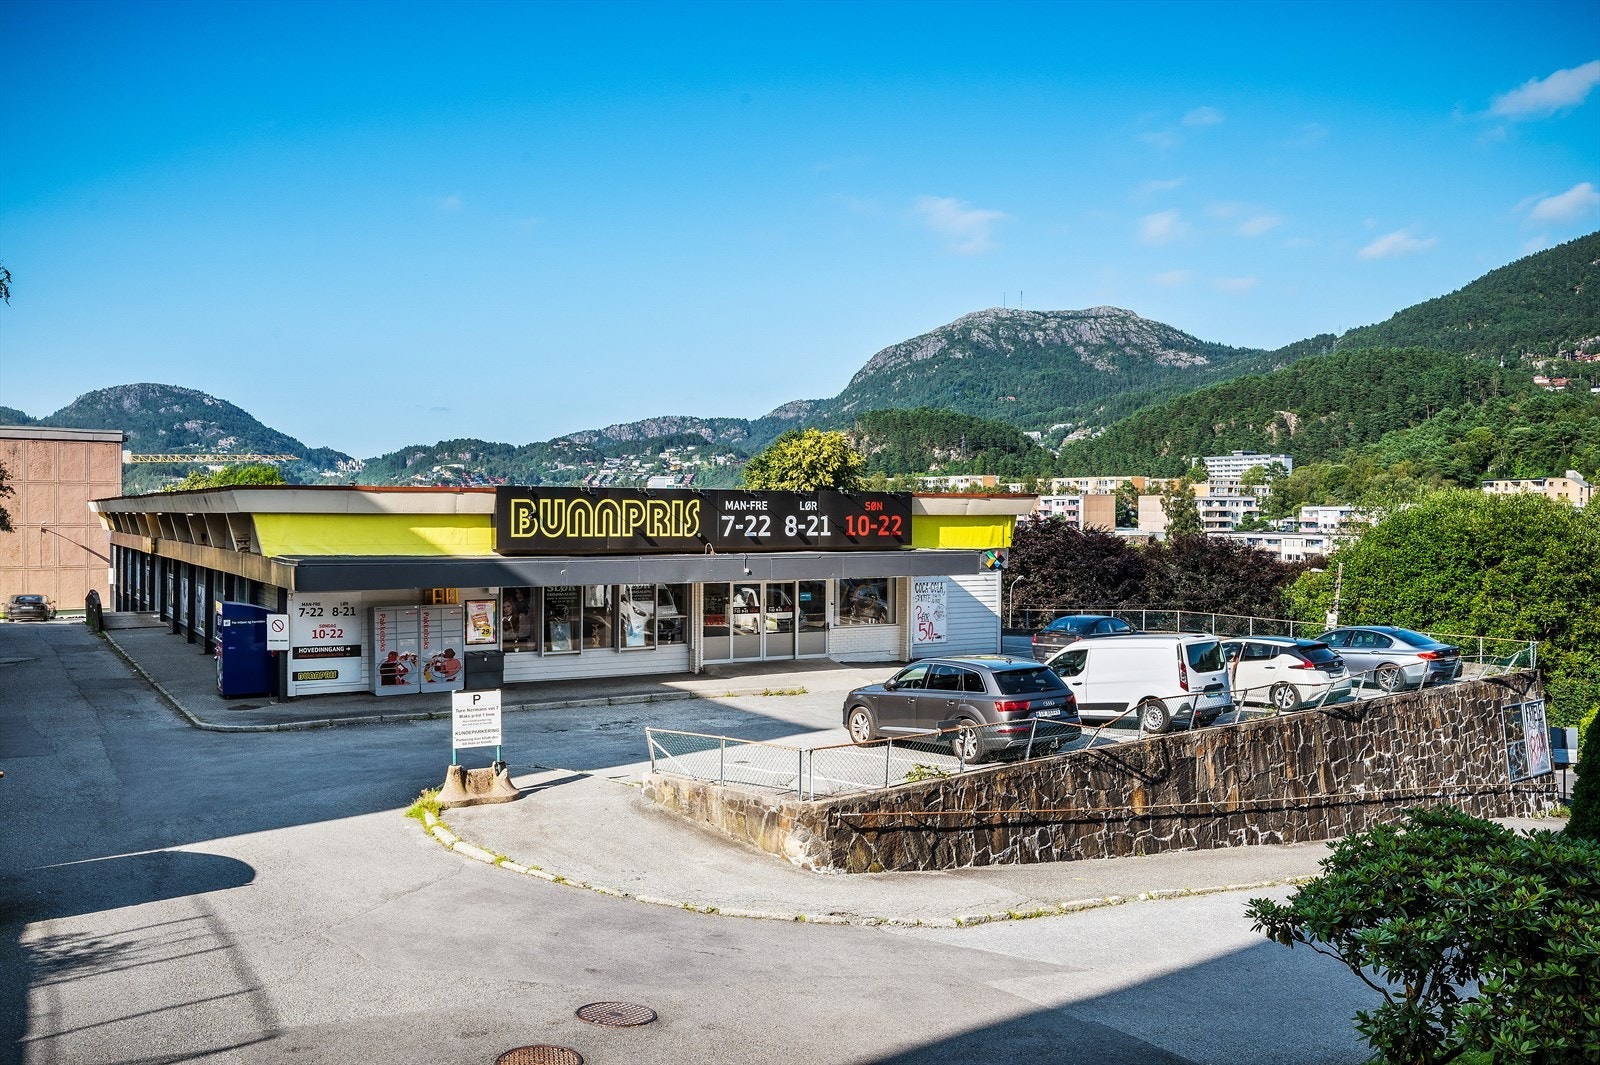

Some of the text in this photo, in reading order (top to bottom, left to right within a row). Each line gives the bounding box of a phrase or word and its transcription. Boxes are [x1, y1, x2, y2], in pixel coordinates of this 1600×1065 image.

[724, 500, 883, 511] MAN-FRE LØR SØN
[510, 498, 700, 538] BUNNPRIS
[721, 514, 903, 537] 7-22 8-21 10-22
[298, 606, 357, 618] 7-22 8-21
[311, 629, 344, 639] 10-22
[298, 646, 345, 654] HOVEDINNGANG
[472, 694, 481, 705] P
[455, 728, 500, 736] KUNDEPARKERING
